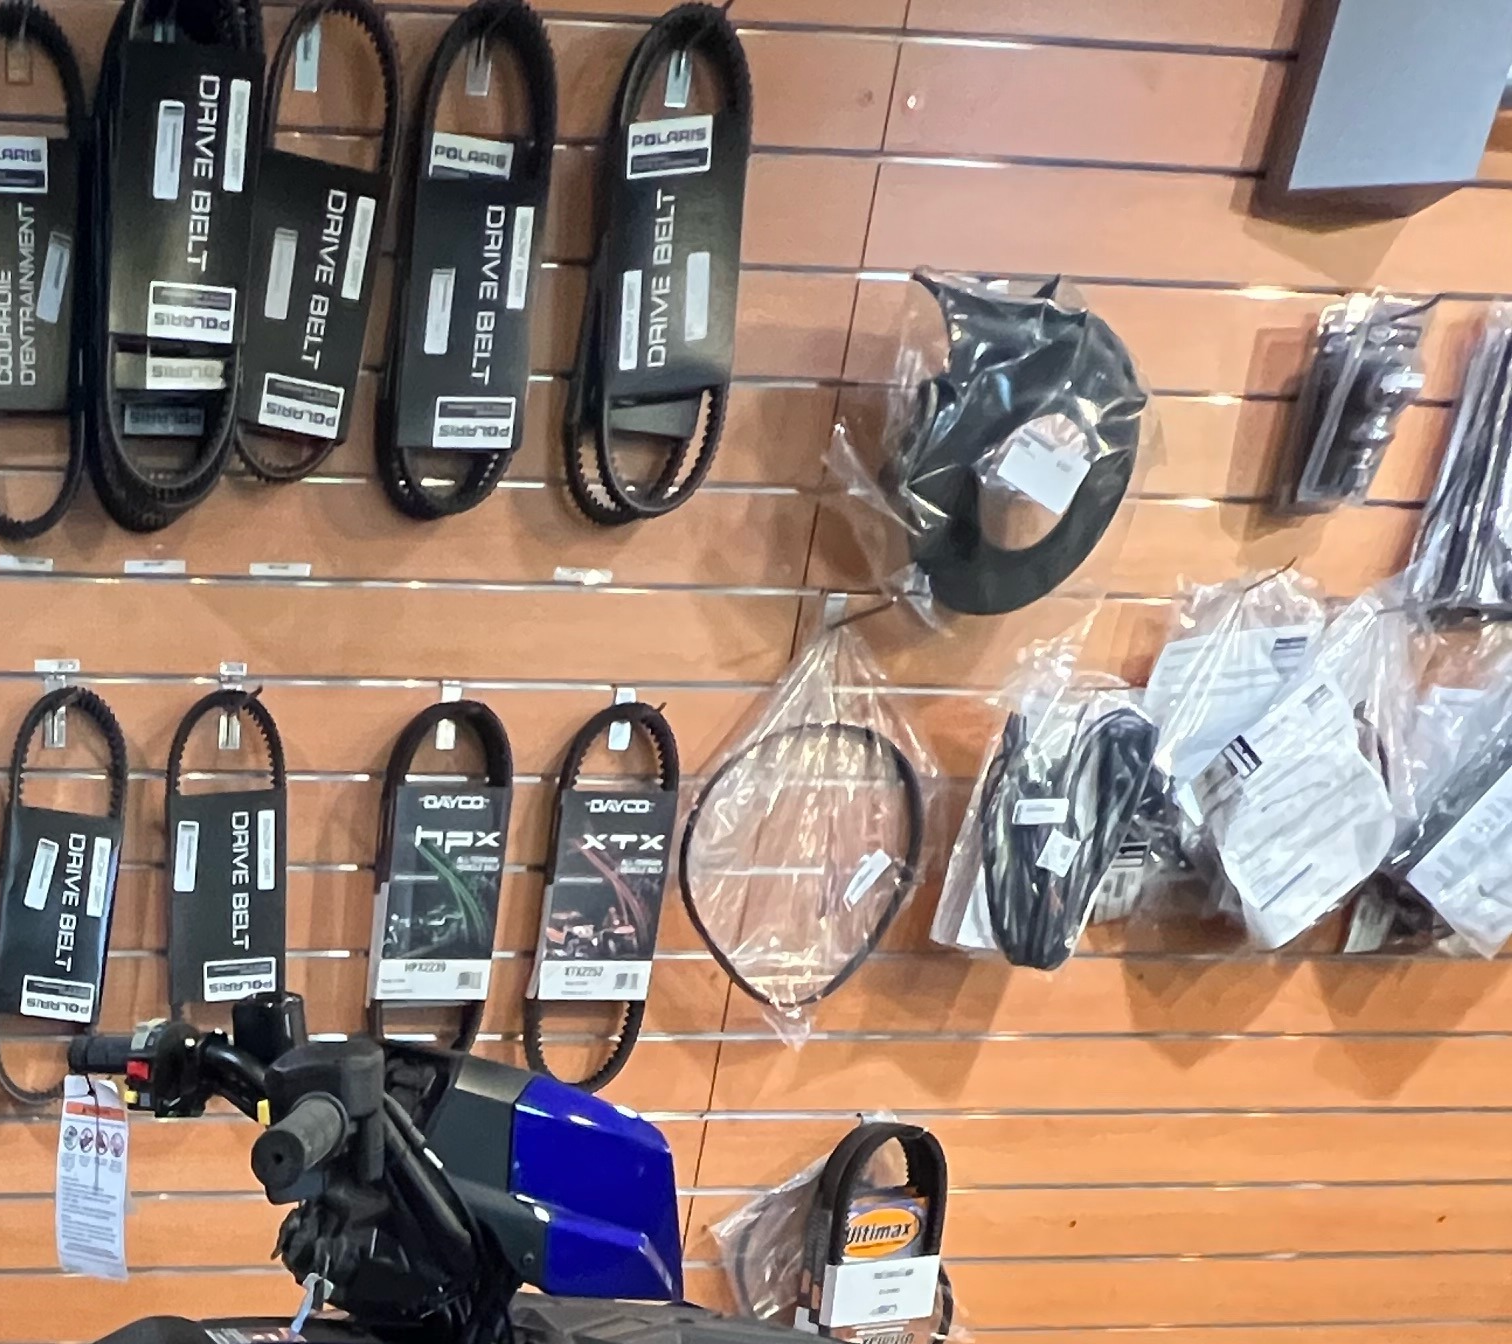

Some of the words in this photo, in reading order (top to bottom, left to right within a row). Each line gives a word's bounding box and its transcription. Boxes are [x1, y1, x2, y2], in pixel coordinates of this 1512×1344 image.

[192, 75, 220, 180] DRIVE
[434, 145, 506, 170] POLARIS
[632, 127, 706, 149] POLARIS
[187, 190, 213, 272] BELT
[314, 189, 347, 286] DRIVE
[478, 204, 505, 301] DRIVE
[652, 188, 676, 265] BELT
[17, 202, 35, 386] D'ENTRAINMENT
[154, 312, 230, 331] POLARIS
[647, 275, 671, 368] DRIVE
[300, 294, 330, 370] BELT
[470, 311, 496, 385] BELT
[266, 402, 336, 428] POLARIS
[438, 424, 509, 438] POLARIS
[422, 794, 485, 809] DAYCO
[589, 799, 651, 813] DAYCO
[61, 833, 86, 906] DRIVE
[232, 811, 249, 886] DRIVE
[54, 914, 77, 972] BELT
[232, 892, 250, 951] BELT
[26, 998, 89, 1014] POLARIS
[209, 979, 273, 994] POLARIS
